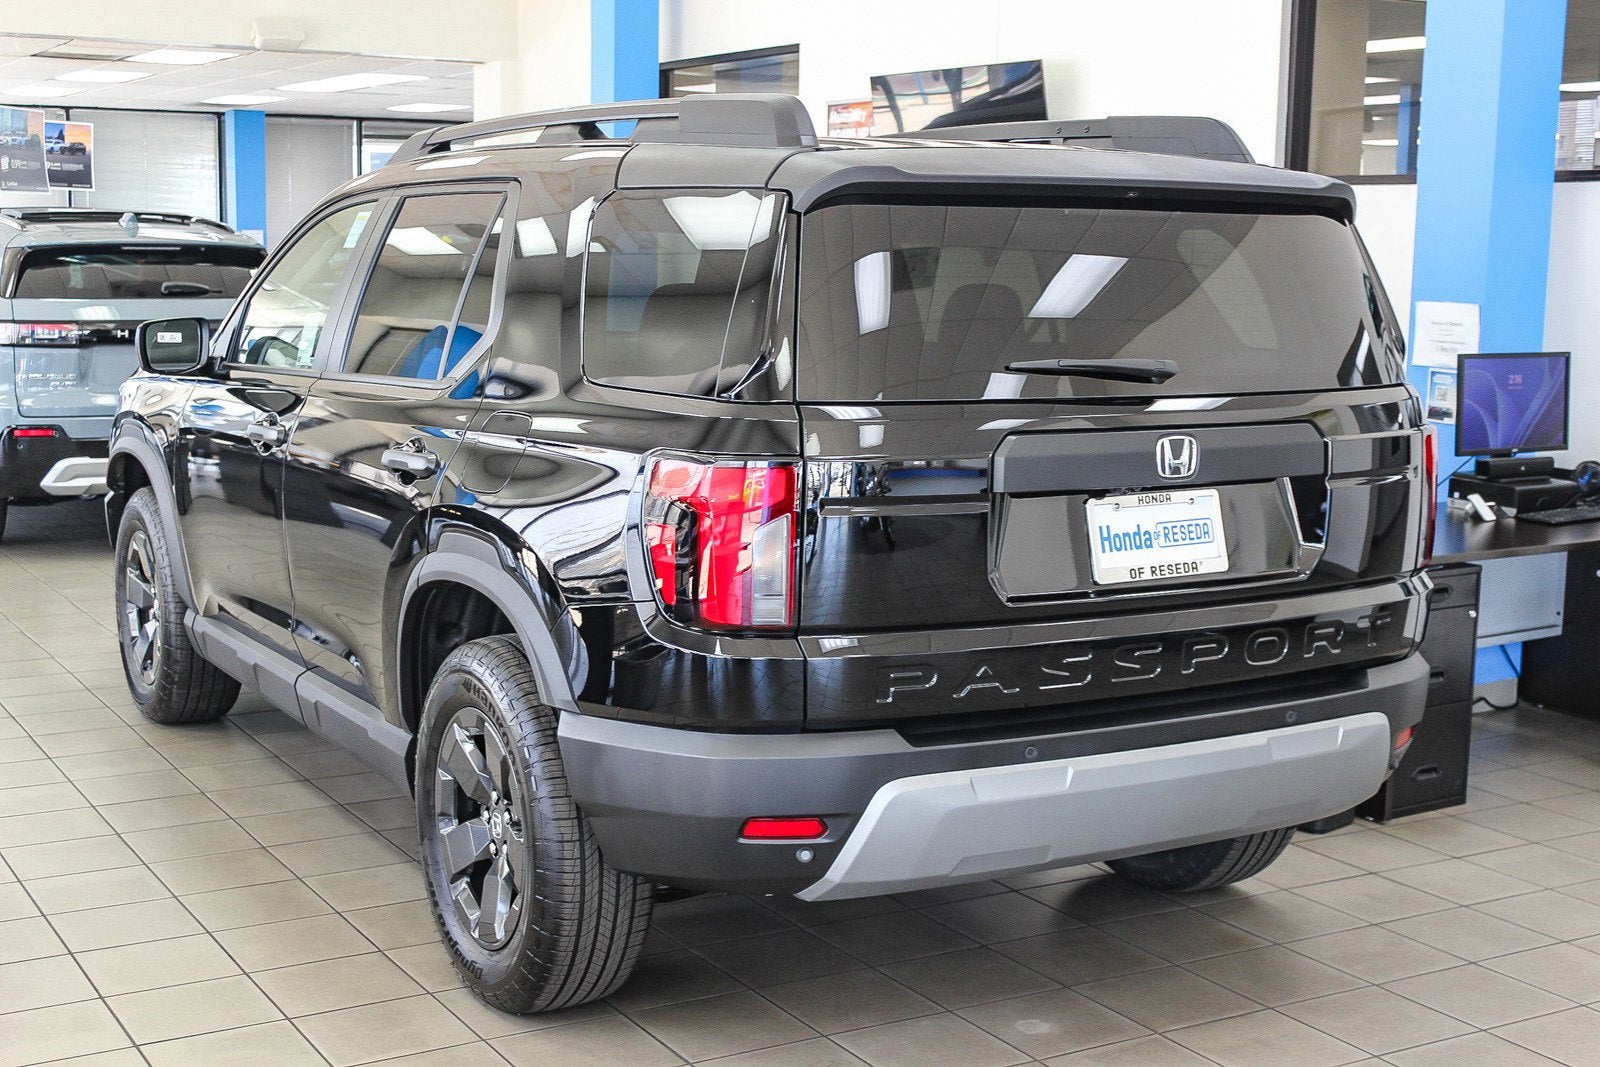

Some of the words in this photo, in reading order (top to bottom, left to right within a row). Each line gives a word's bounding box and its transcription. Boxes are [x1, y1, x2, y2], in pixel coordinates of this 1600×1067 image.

[1138, 493, 1172, 505] HONDA
[1098, 524, 1154, 554] Honda
[1162, 522, 1211, 544] RESEDA
[1129, 567, 1145, 580] OF
[1150, 561, 1199, 577] RESEDA
[876, 605, 1392, 704] PASSPORT
